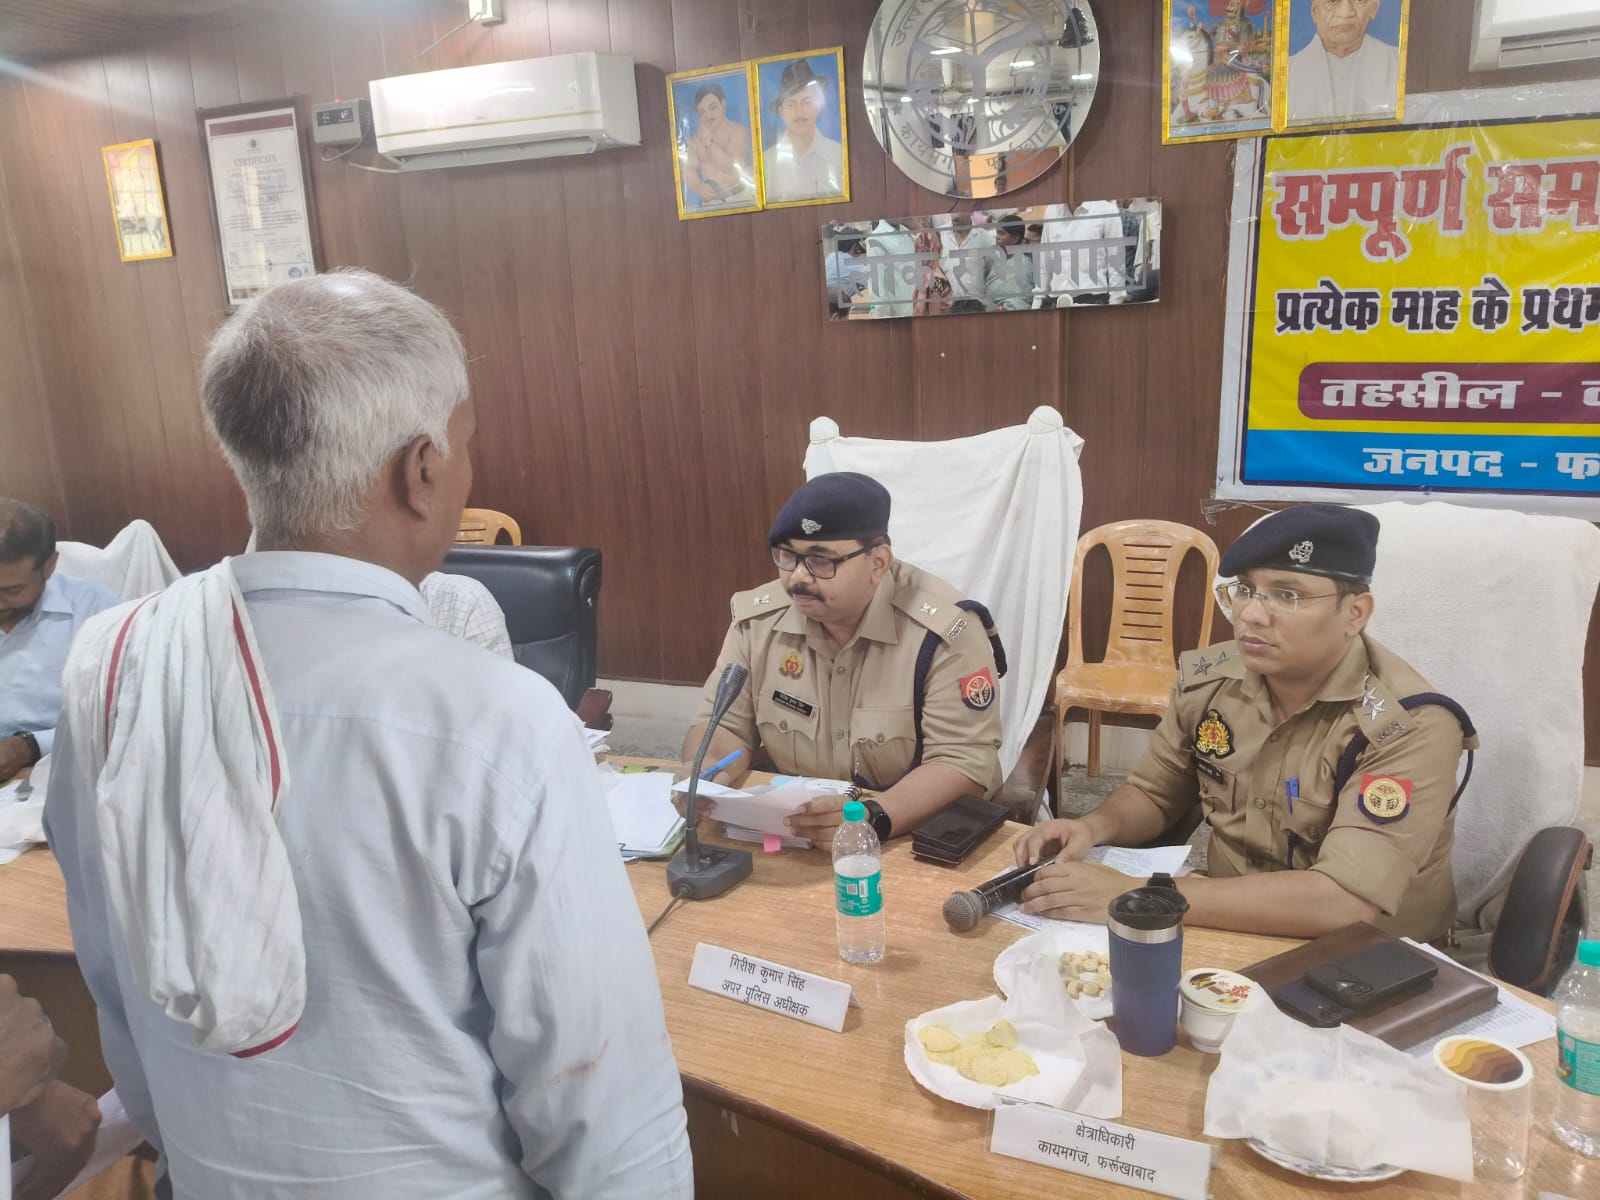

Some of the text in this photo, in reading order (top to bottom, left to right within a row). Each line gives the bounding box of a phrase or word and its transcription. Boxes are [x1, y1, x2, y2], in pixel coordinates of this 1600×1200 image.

[1274, 144, 1472, 260] सम्पूर्ण
[1275, 278, 1380, 333] प्रत्येक
[1391, 289, 1459, 331] माह
[1472, 275, 1510, 331] के
[1320, 372, 1524, 409] तहसील
[1362, 447, 1505, 478] जनपद
[730, 953, 806, 991] गिरीश कुमार सिंह
[722, 979, 810, 1016] अपर पुलिस अधीक्षक
[1038, 1140, 1090, 1167] कायमगंज,
[1075, 1120, 1136, 1150] क्षेत्राधिकारी
